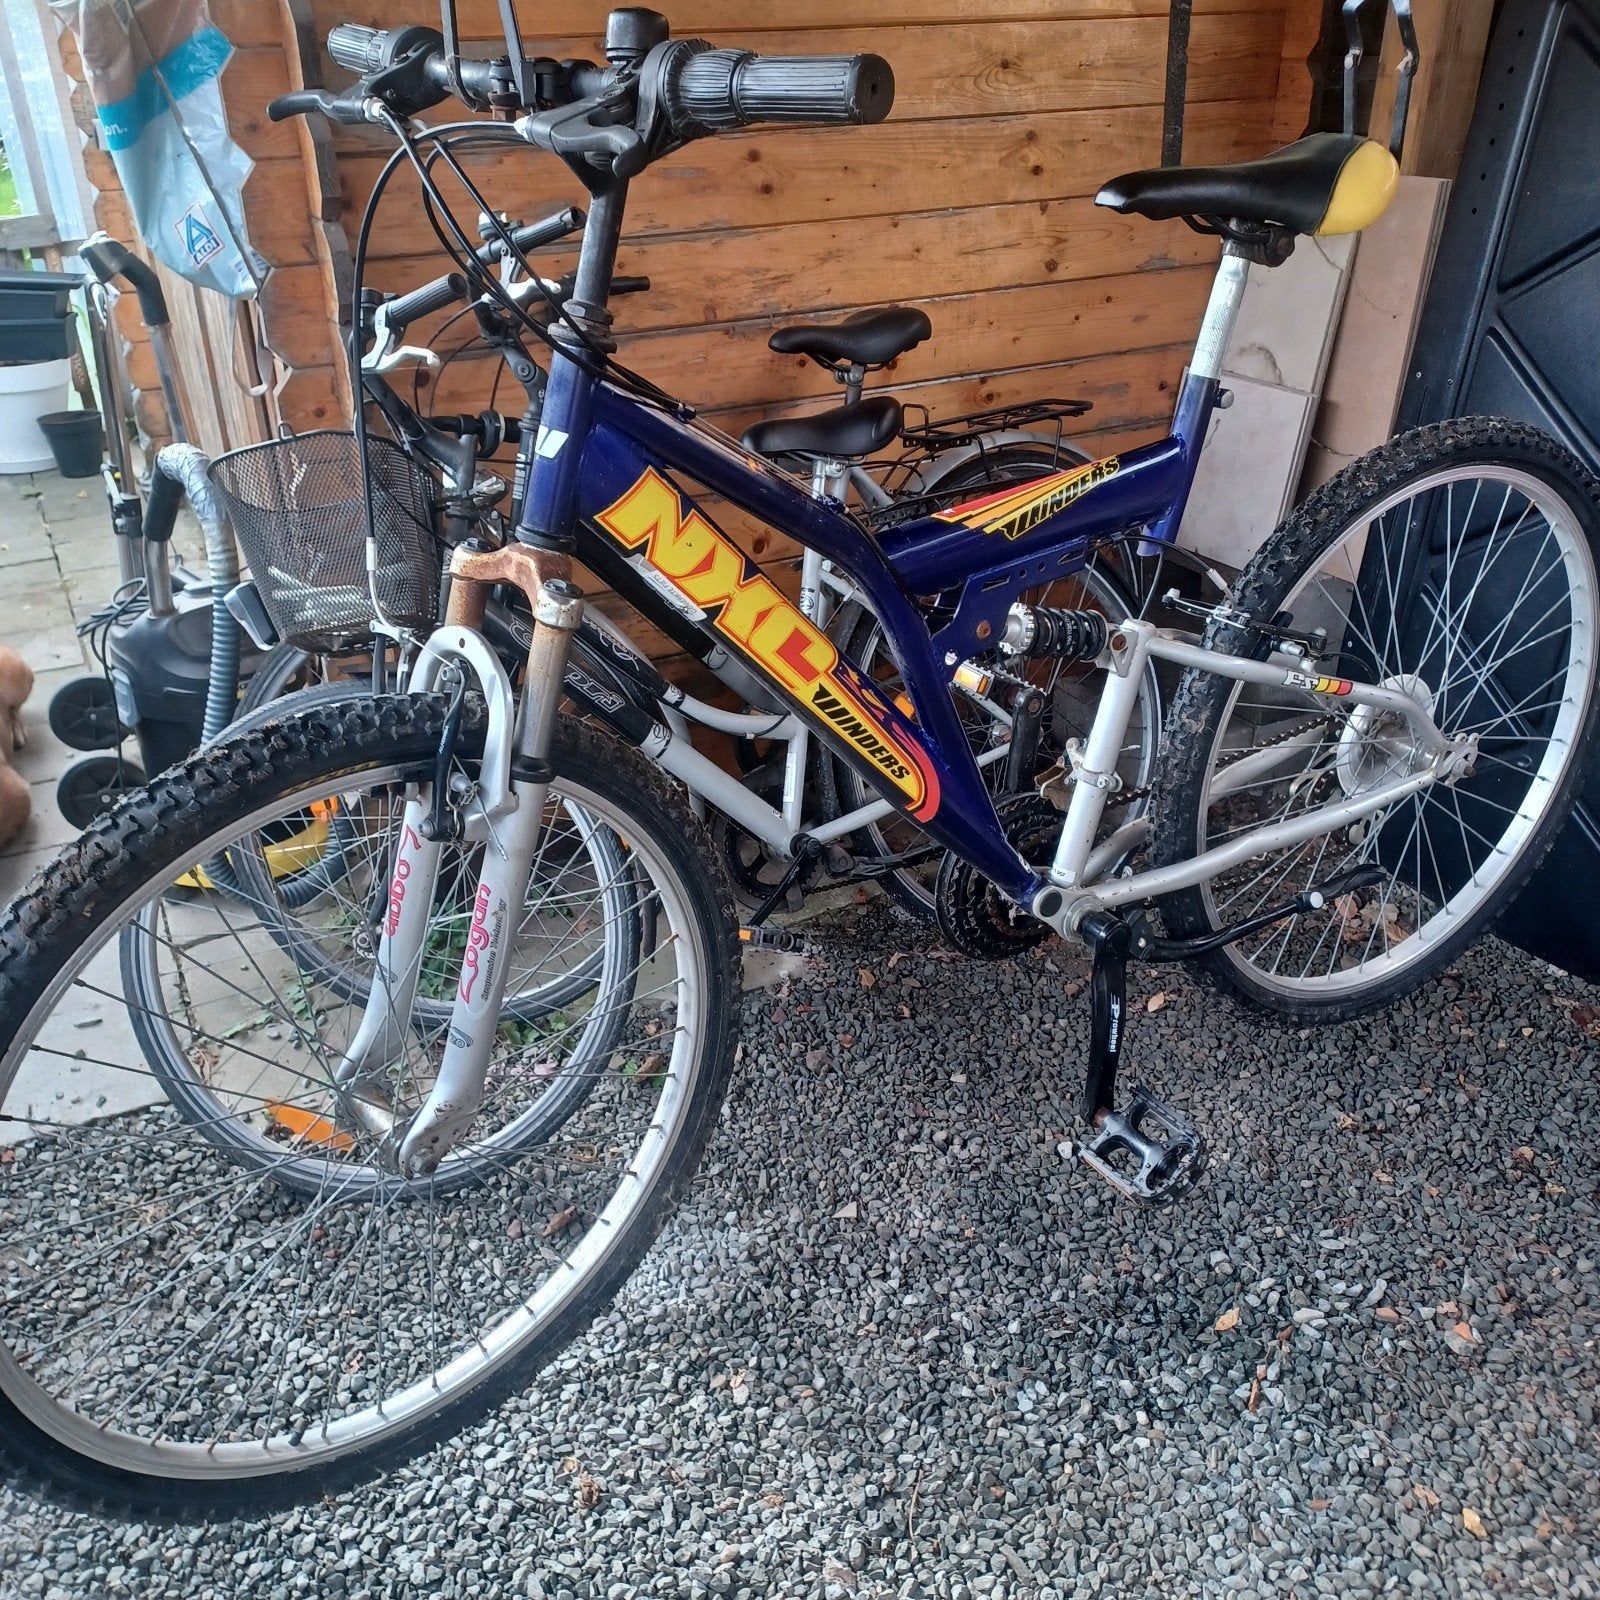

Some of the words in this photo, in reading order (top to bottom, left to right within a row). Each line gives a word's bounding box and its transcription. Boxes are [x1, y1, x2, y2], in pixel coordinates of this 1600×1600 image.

[193, 238, 220, 264] ALDI
[593, 465, 838, 693] NXC
[811, 682, 911, 780] WINDERS
[385, 824, 422, 937] Logan
[459, 883, 491, 1005] Logan
[1109, 992, 1120, 1053] Prowheel
